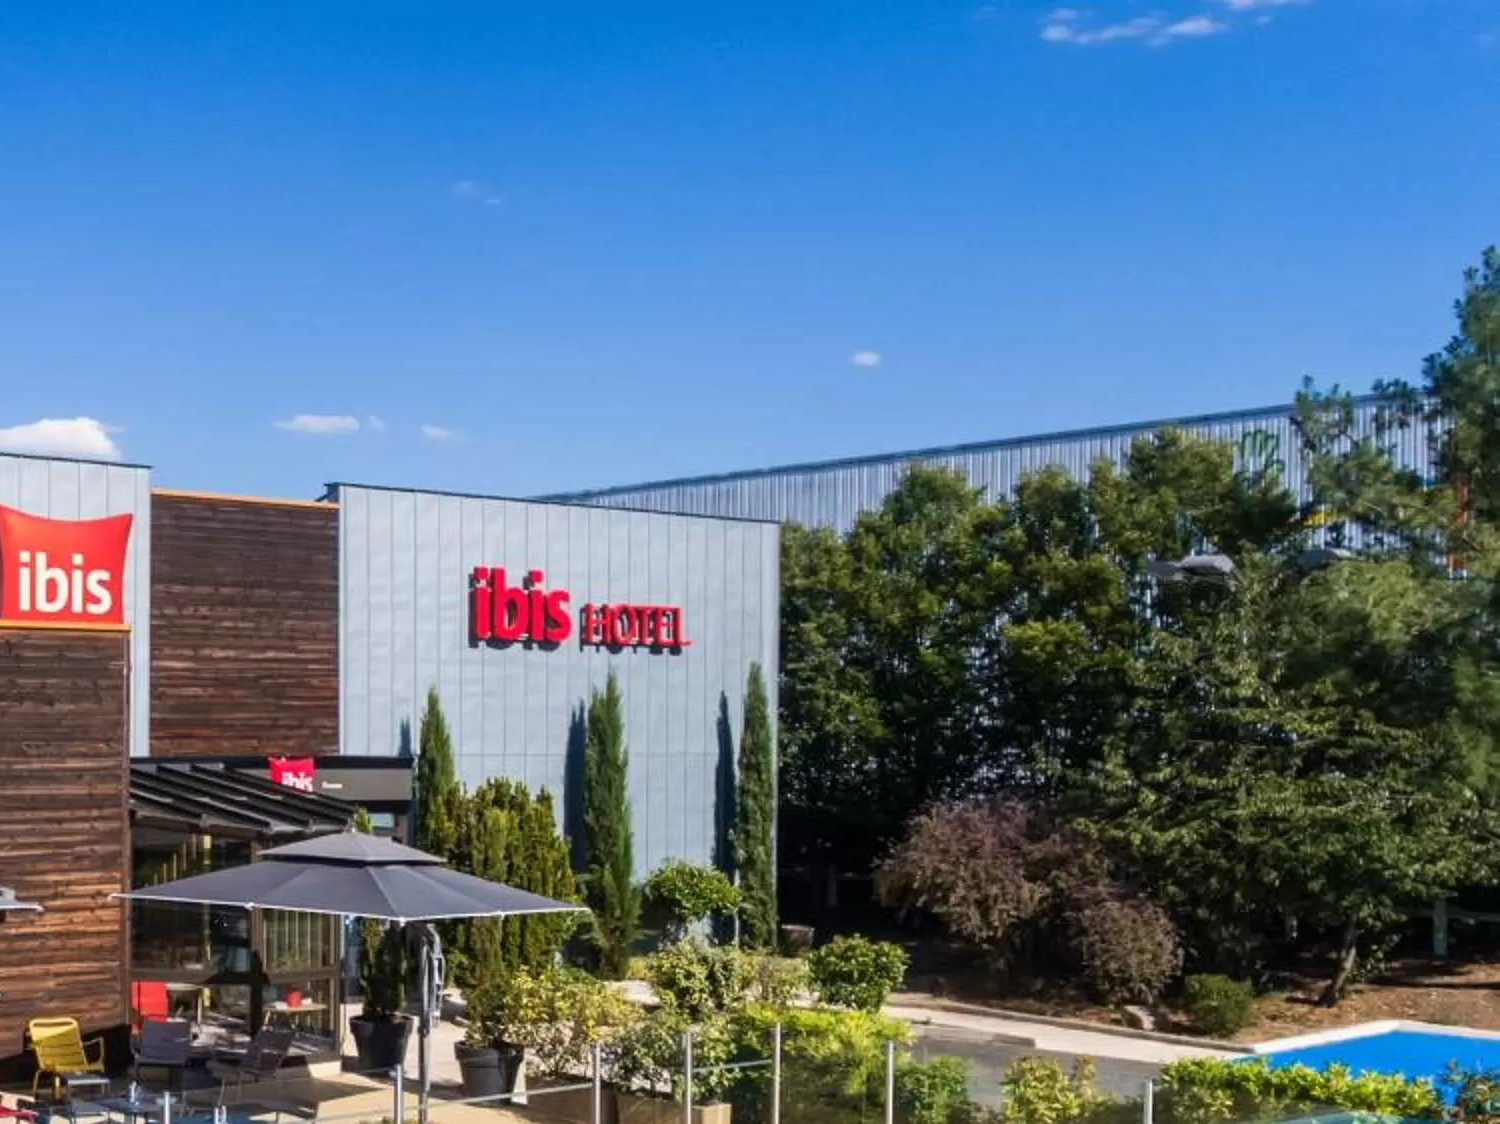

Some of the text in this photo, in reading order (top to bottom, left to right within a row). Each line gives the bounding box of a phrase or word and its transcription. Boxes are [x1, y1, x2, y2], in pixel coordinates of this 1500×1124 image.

[18, 551, 112, 615] ibis
[473, 566, 692, 646] ibis HOTEL
